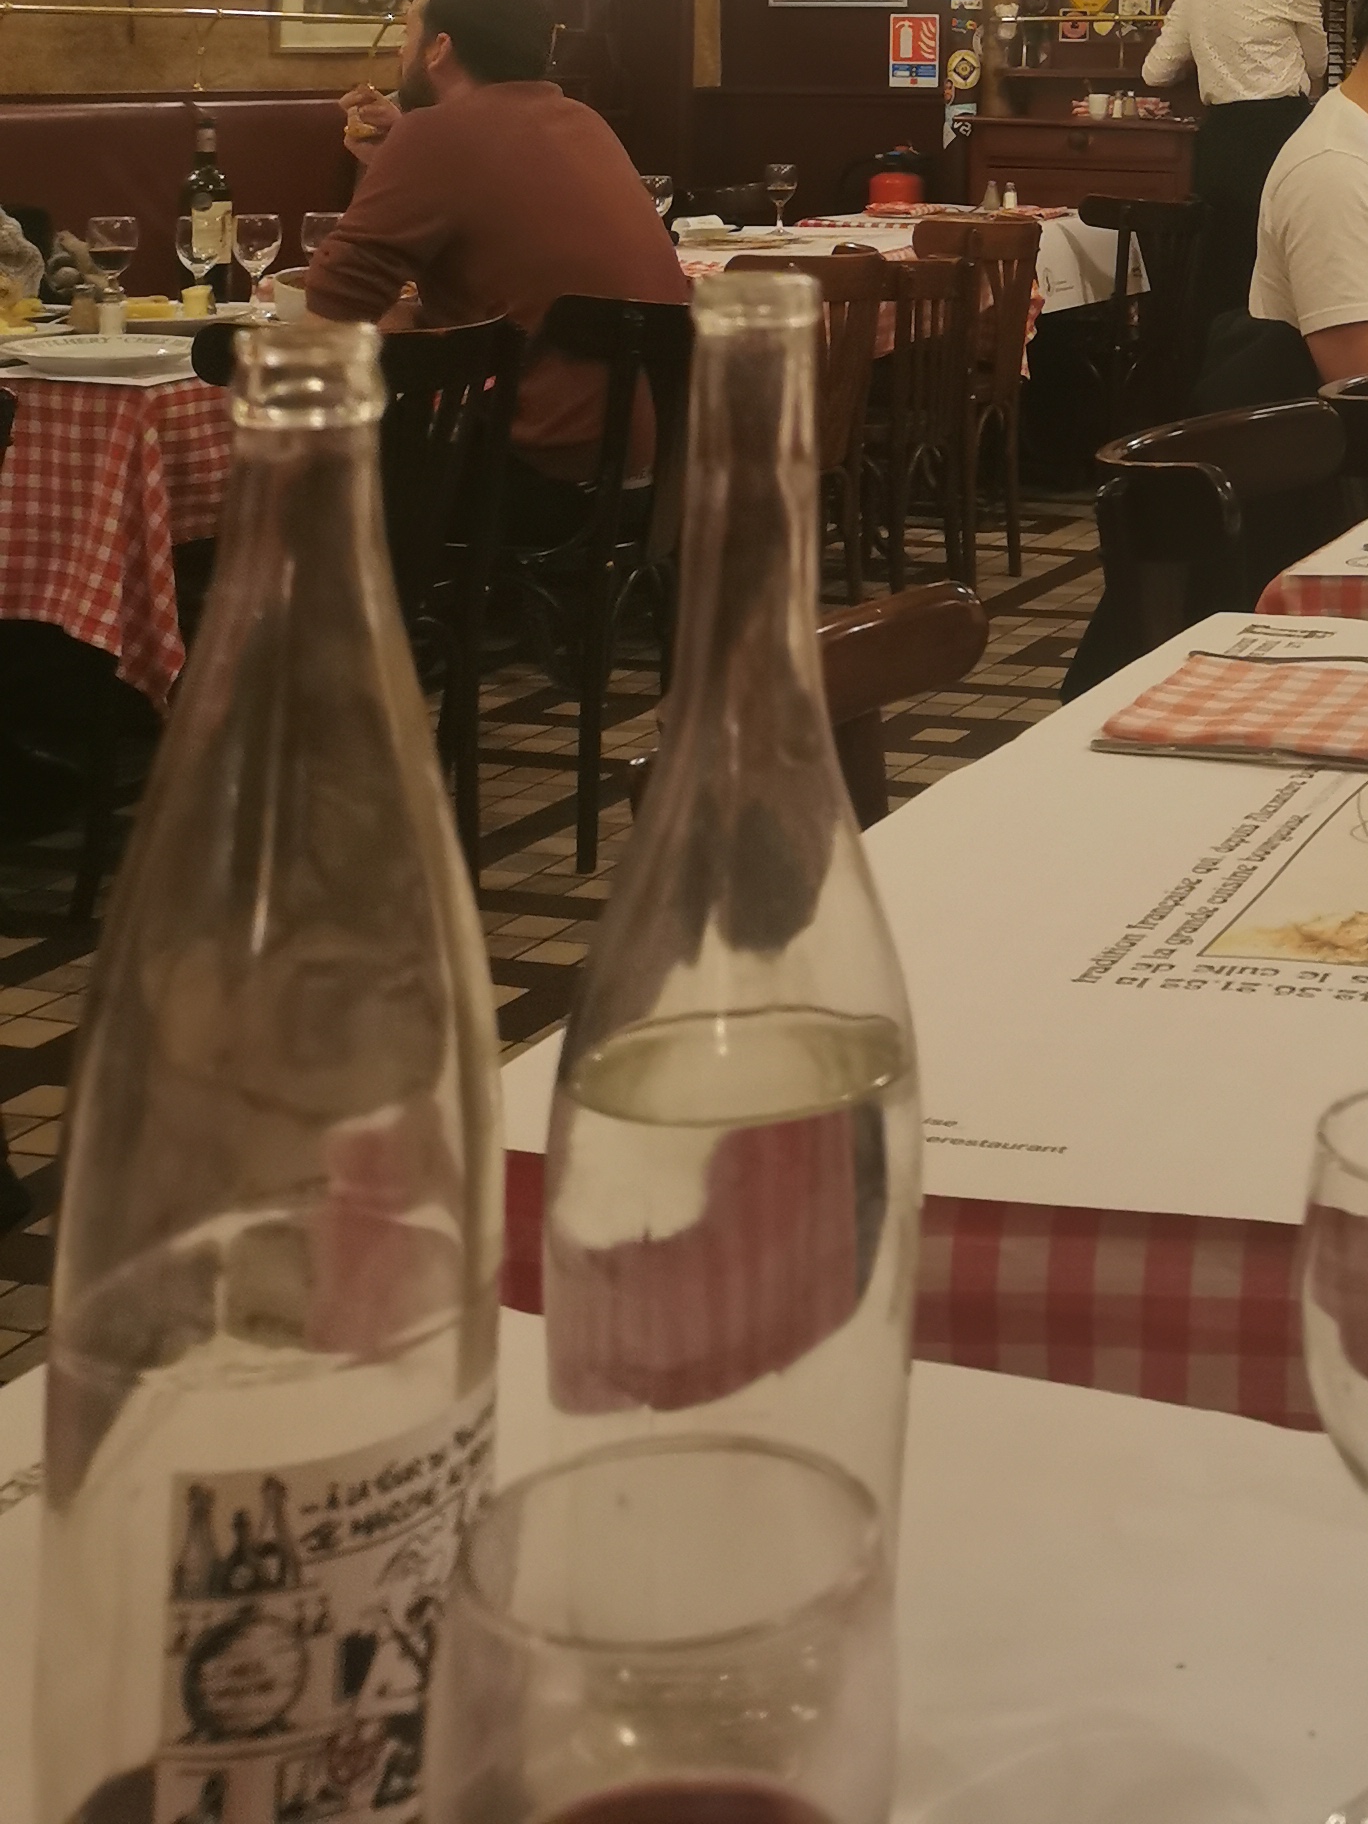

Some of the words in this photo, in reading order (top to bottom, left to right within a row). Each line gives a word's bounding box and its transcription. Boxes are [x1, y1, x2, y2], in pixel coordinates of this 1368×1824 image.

[1206, 864, 1259, 906] cuisine
[1130, 962, 1177, 974] de
[1115, 976, 1150, 989] la
[1298, 970, 1333, 984] le
